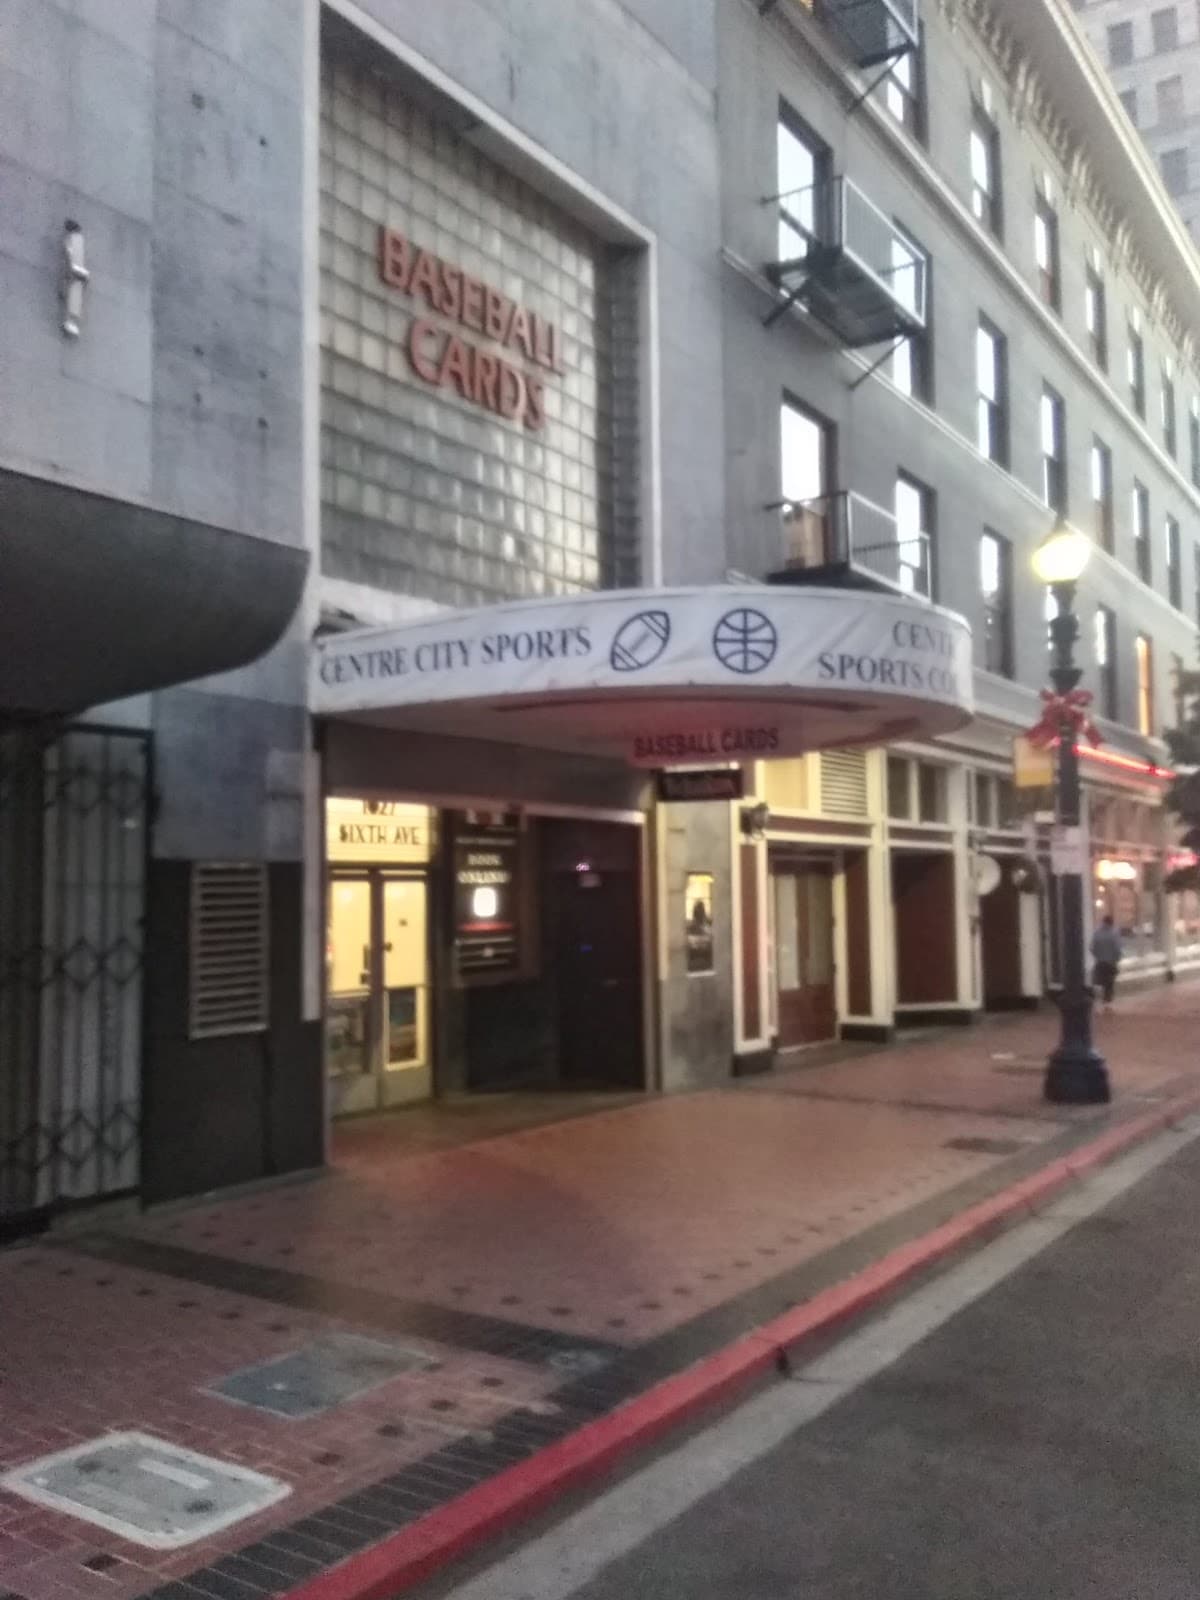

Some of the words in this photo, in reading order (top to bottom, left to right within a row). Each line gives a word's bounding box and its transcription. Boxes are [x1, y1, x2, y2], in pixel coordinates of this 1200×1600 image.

[376, 223, 567, 377] BASEBALL
[406, 318, 547, 432] CARDS
[319, 646, 409, 687] CENTRE
[414, 637, 477, 673] CITY
[481, 626, 593, 663] SPORTS
[817, 652, 924, 690] SPORTS
[633, 731, 719, 758] BASEBALL
[721, 727, 779, 752] CARDS
[340, 823, 388, 844] SIXTH
[392, 825, 421, 846] AVE
